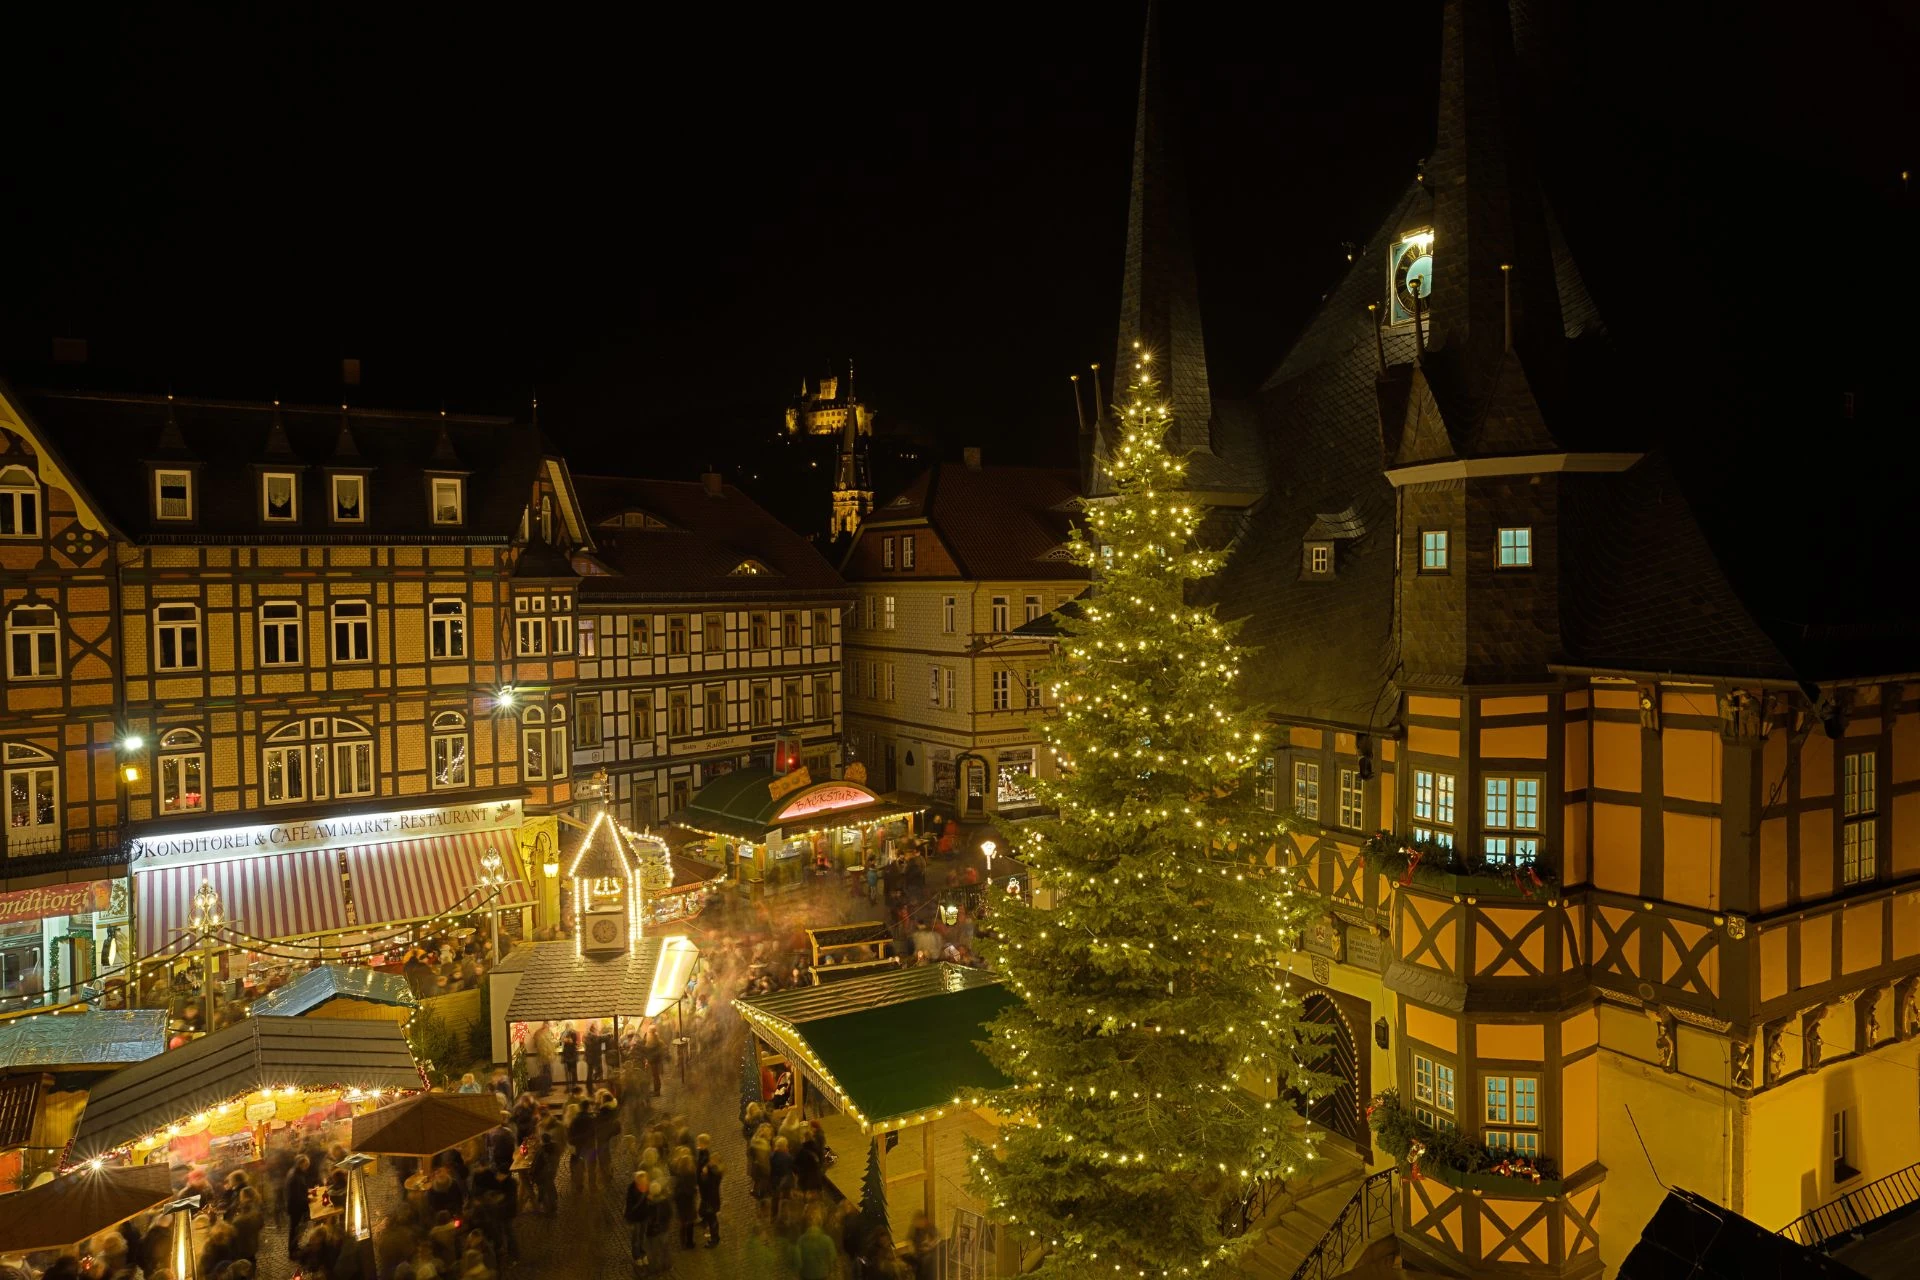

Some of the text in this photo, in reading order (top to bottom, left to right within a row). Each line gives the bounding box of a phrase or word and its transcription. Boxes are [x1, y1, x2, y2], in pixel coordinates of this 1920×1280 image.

[795, 789, 860, 811] BACKSTUBE
[144, 832, 250, 858] KONDITOREI
[254, 832, 266, 846] &
[270, 822, 310, 844] CAFÉ
[313, 823, 337, 840] AM
[341, 817, 392, 836] MARKT
[400, 807, 489, 830] RESTAURANT
